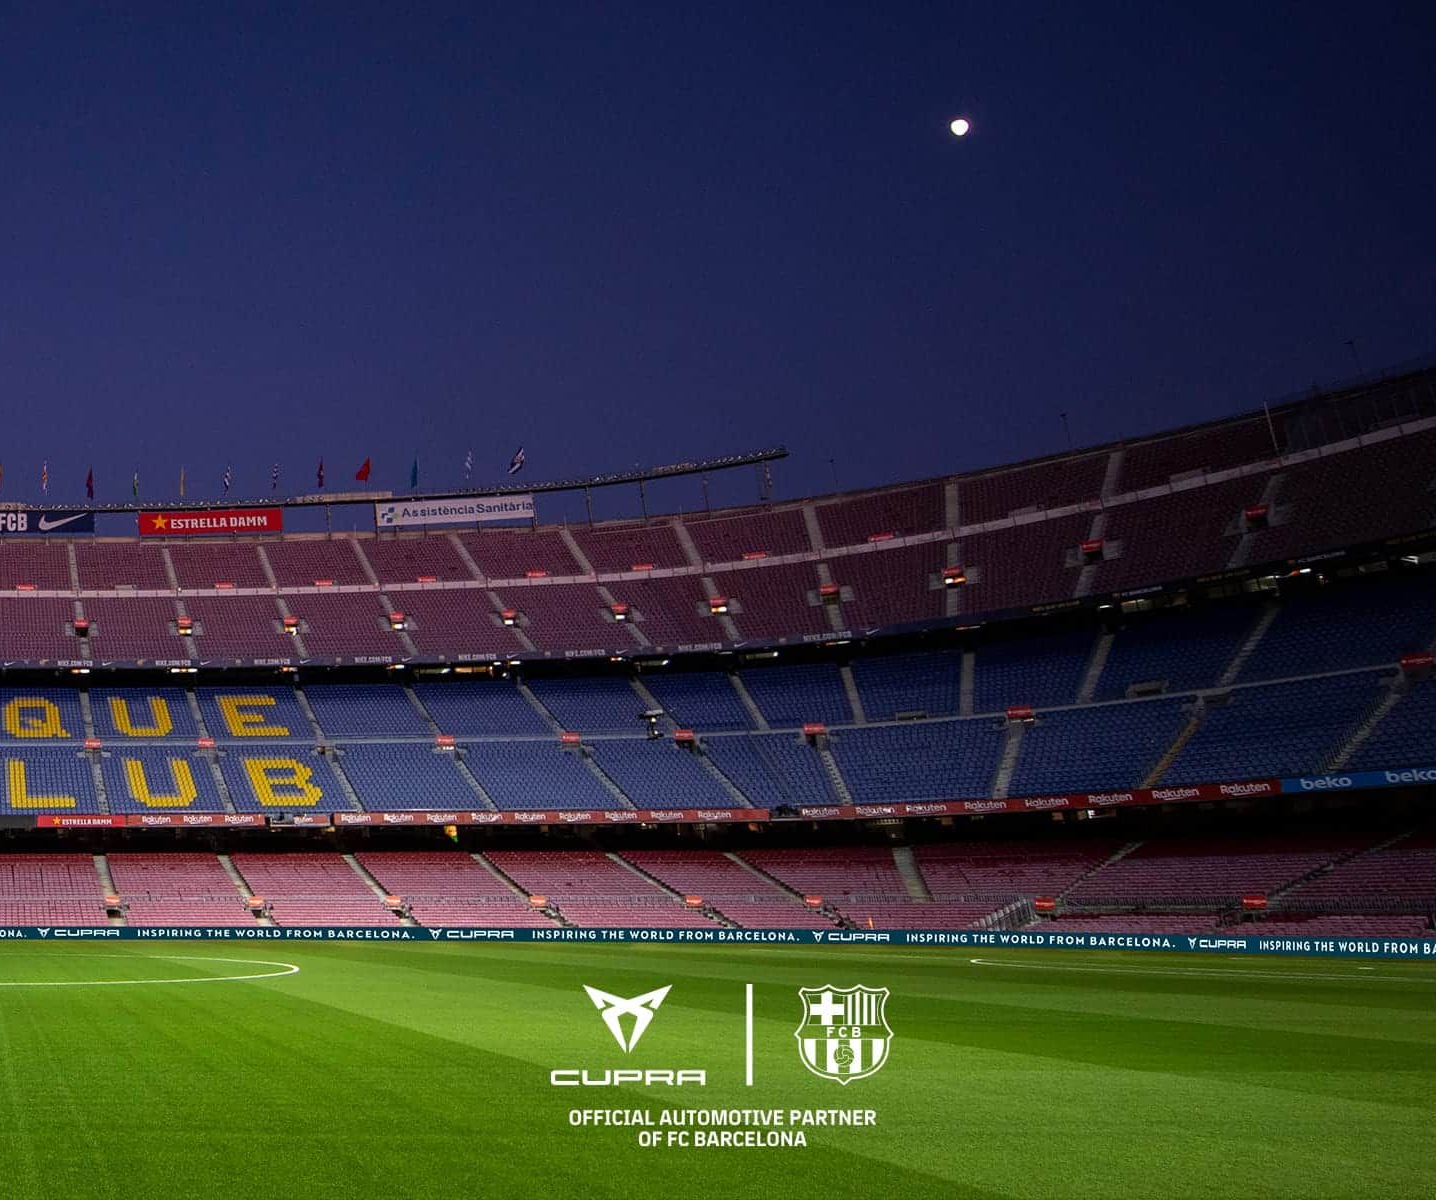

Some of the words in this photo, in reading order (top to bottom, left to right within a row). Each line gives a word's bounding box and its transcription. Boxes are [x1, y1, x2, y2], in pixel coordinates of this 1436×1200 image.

[402, 503, 474, 518] Assistència
[170, 517, 228, 529] ESTRELLA
[230, 516, 268, 527] DAMM
[5, 697, 289, 738] QUE
[1300, 776, 1352, 791] beko
[1152, 788, 1200, 800] Rakuten
[1220, 782, 1270, 796] Rakuten
[1088, 793, 1133, 805] Rakuten
[906, 804, 947, 814] Rakuten
[964, 800, 1007, 811] Rakuten
[426, 813, 457, 822] Rakuten
[514, 813, 546, 822] Rakuten
[559, 812, 591, 822] Rakuten
[605, 812, 637, 821] Rakuten
[651, 811, 684, 820] Rakuten
[698, 811, 732, 820] Rakuten
[802, 808, 840, 817] Rakuten
[142, 815, 172, 824] Rakuten
[183, 815, 212, 824] Rakuten
[225, 815, 254, 824] Rakuten
[341, 814, 372, 824] Rakuten
[383, 814, 414, 822] Rakuten
[54, 929, 120, 937] CUPRA
[137, 929, 202, 937] INSPIRING
[206, 929, 230, 938] THE
[235, 929, 282, 938] WORLD
[286, 929, 323, 938] FROM
[327, 929, 415, 939] BARCELONA.
[446, 930, 515, 939] CUPRA
[532, 930, 597, 940] INSPIRING
[600, 930, 625, 940] THE
[629, 930, 674, 940] WORLD
[678, 930, 714, 941] FROM
[718, 931, 800, 941] BARCELONA.
[827, 932, 890, 942] CUPRA
[906, 933, 968, 943] INSPIRING
[971, 934, 996, 944] THE
[999, 934, 1045, 945] WORLD
[1049, 935, 1085, 945] FROM
[1089, 936, 1176, 948] BARCELONA.
[1199, 939, 1247, 949] CUPRA
[1259, 940, 1311, 952] INSPIRING
[1313, 941, 1335, 952] THE
[1338, 941, 1380, 953] WORLD
[1383, 942, 1419, 954] FROM
